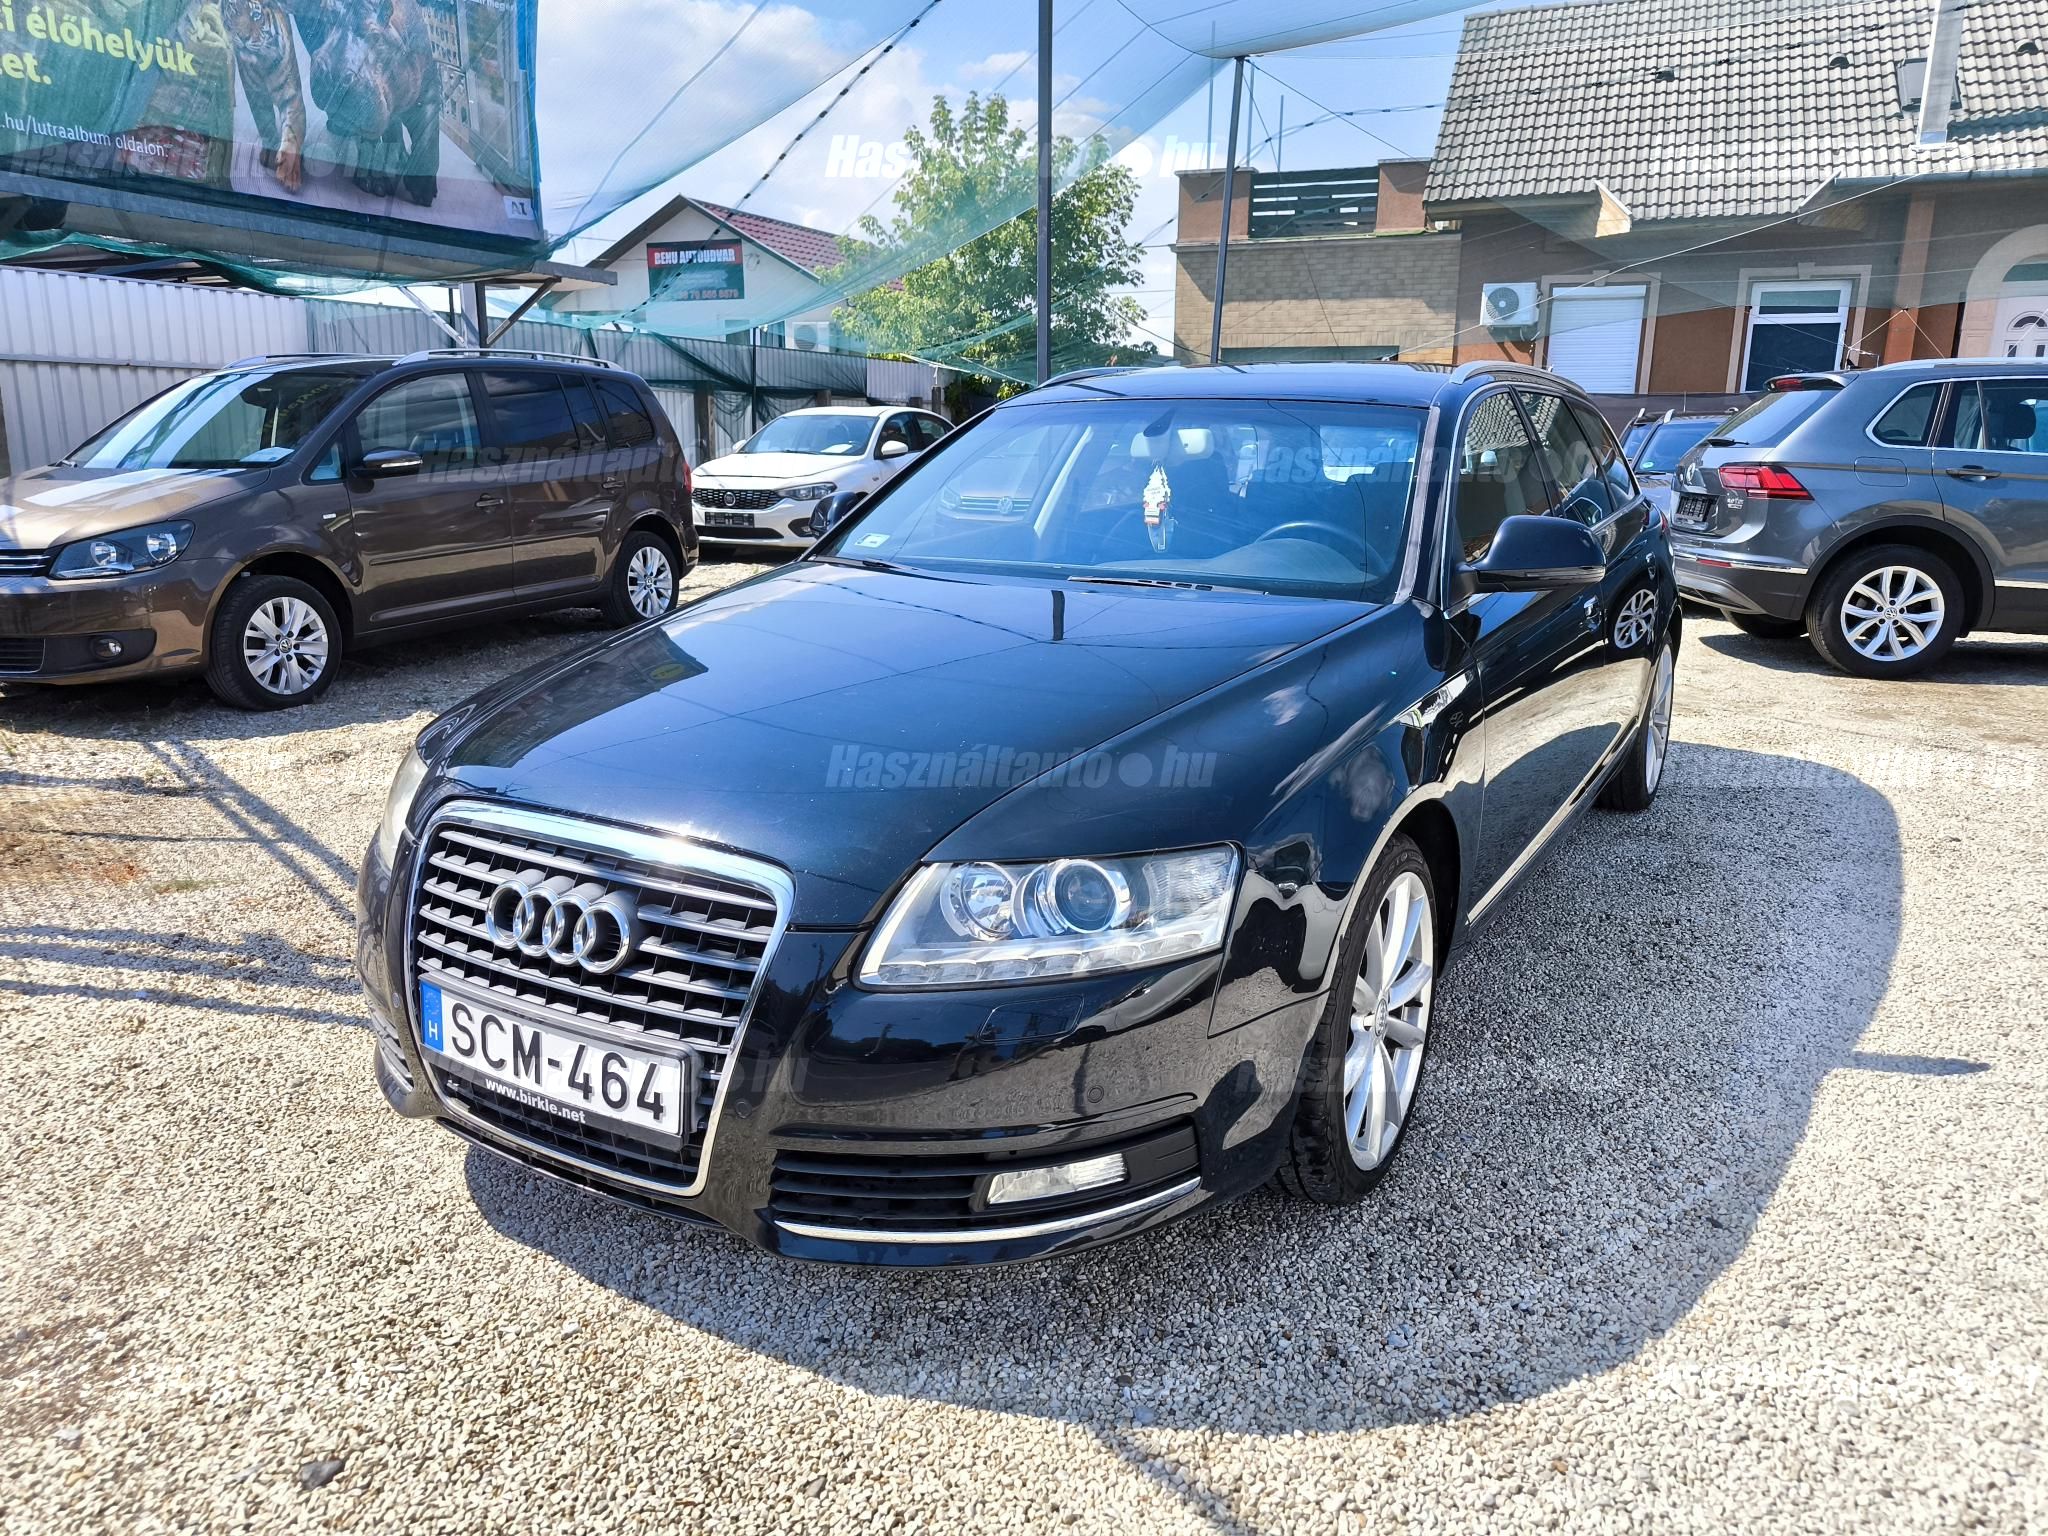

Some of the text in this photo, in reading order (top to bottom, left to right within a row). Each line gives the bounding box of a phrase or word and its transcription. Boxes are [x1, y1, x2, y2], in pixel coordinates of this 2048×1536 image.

[26, 5, 197, 77] élőhelyük
[115, 133, 170, 158] oldalon.
[428, 1019, 439, 1041] H
[451, 1002, 665, 1121] SCM-464
[485, 1076, 586, 1125] www.birkle.net
